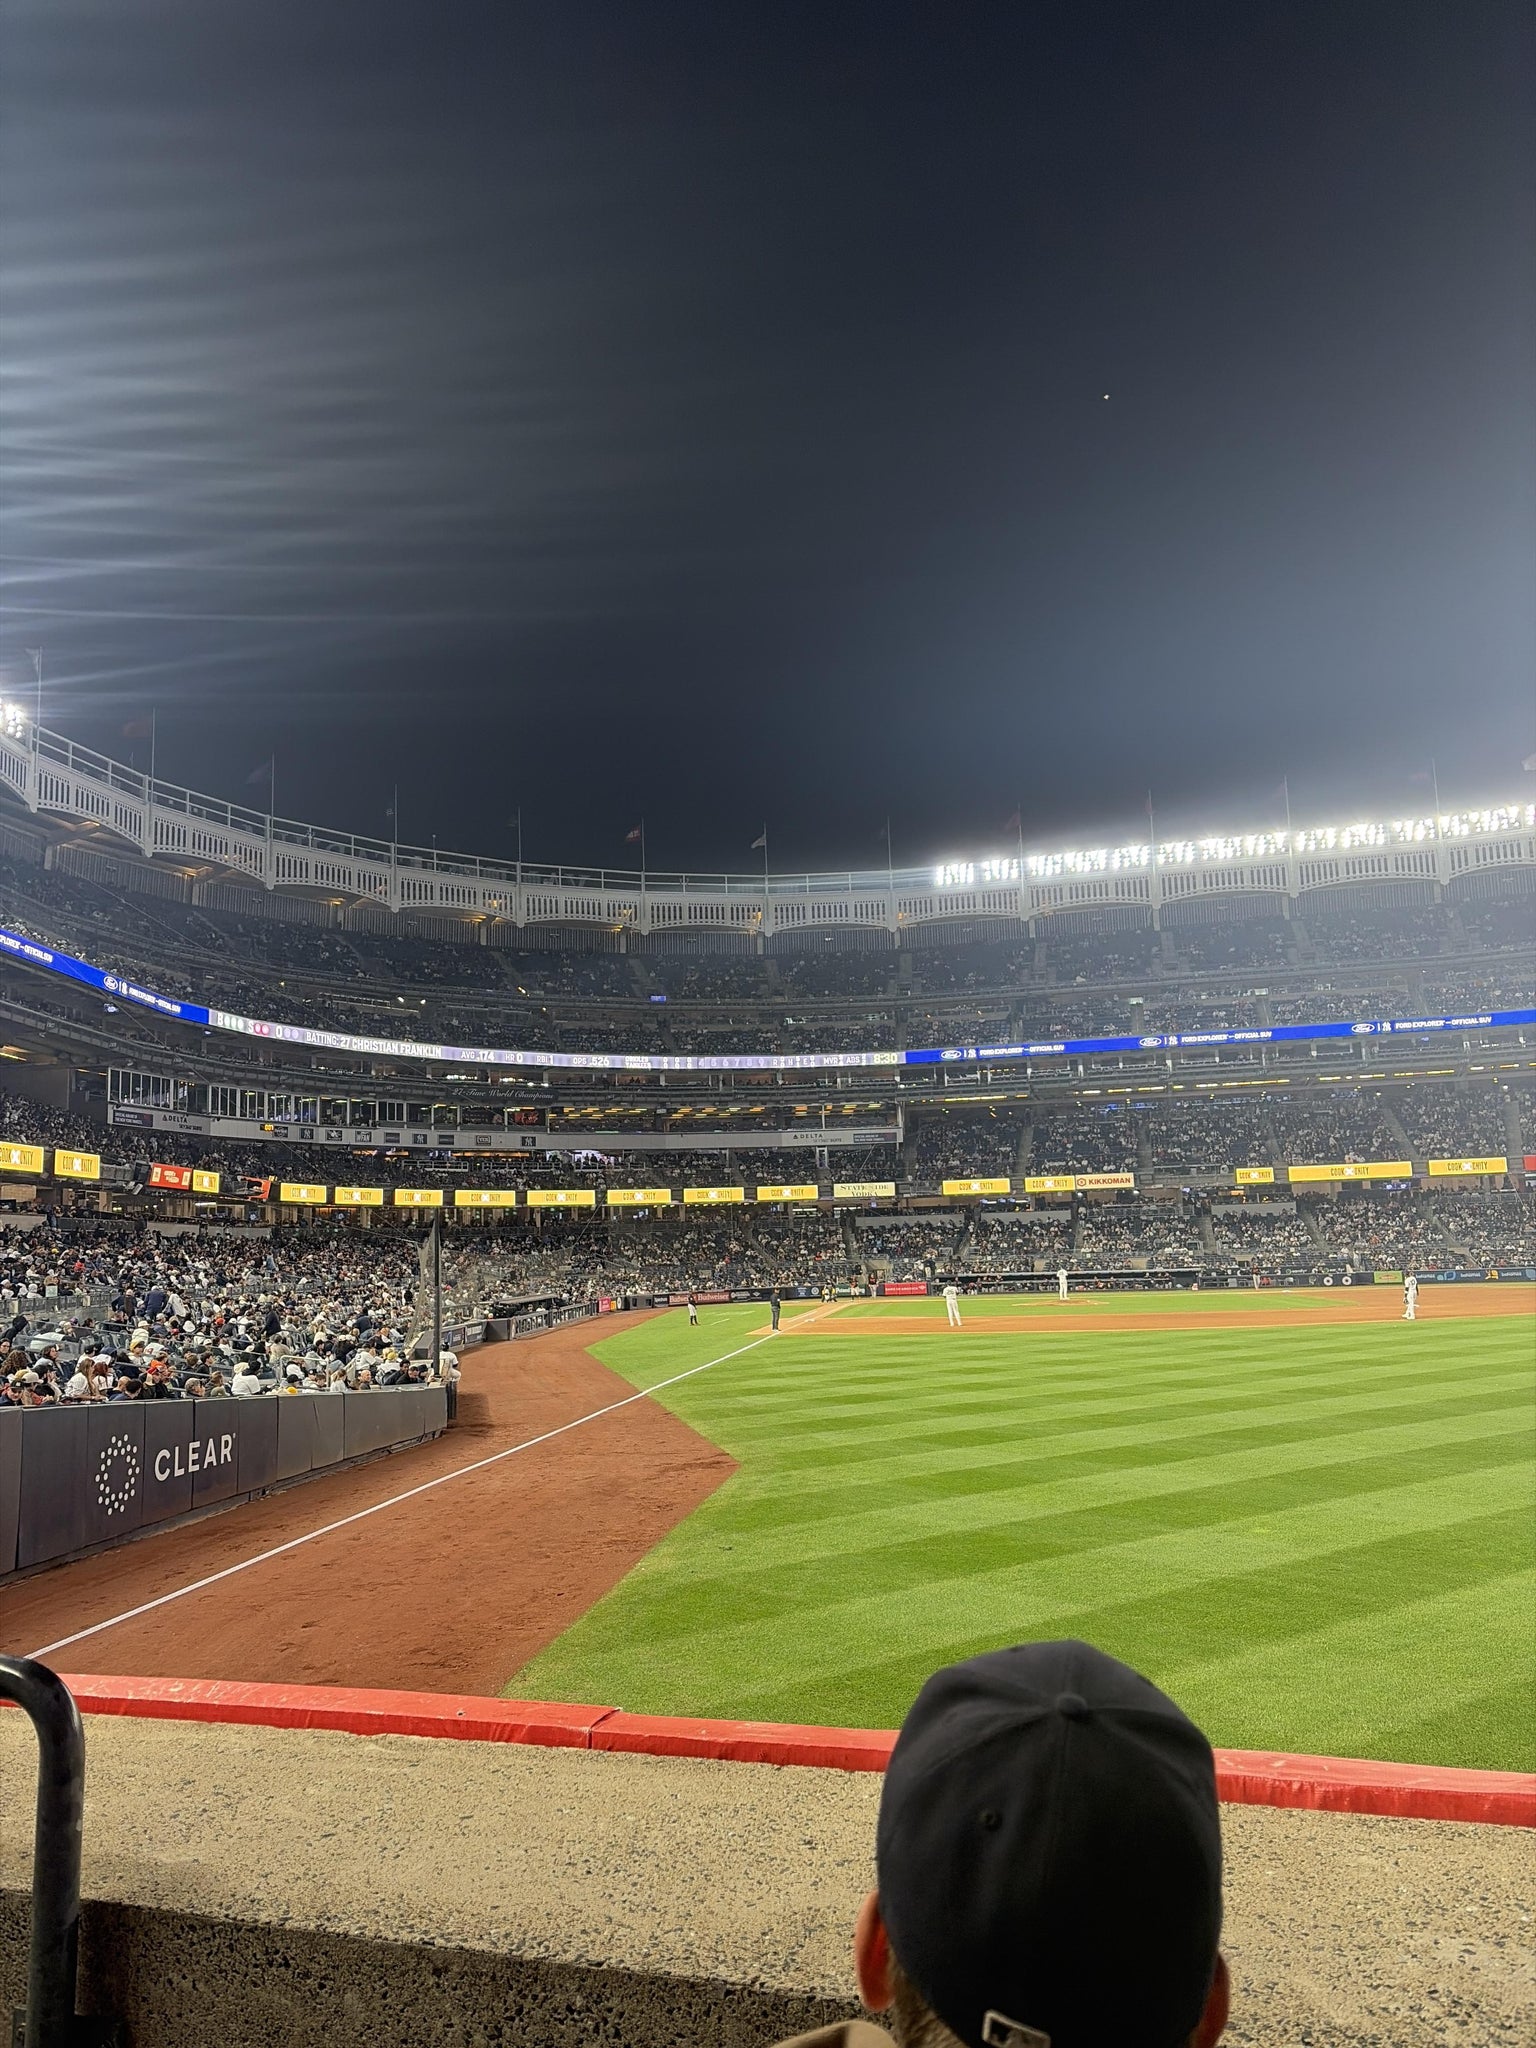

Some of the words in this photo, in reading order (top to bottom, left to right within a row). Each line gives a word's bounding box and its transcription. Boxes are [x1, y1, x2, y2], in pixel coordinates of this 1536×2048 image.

[1395, 1022, 1412, 1030] FORD
[1412, 1020, 1444, 1028] EXPLORER
[1451, 1018, 1478, 1026] OFFICIAL
[1479, 1016, 1492, 1024] SUV
[217, 1012, 223, 1026] B
[248, 1021, 254, 1033] S
[306, 1032, 340, 1046] BATTING:
[341, 1037, 350, 1048] 27
[352, 1039, 397, 1054] CHRISTIAN
[400, 1044, 442, 1057] FRANKLIN
[461, 1051, 475, 1059] AVG
[476, 1051, 495, 1061] .174
[505, 1053, 515, 1061] HR
[516, 1053, 523, 1062] 0
[536, 1055, 548, 1063] RBI
[589, 1056, 609, 1066] .526
[1234, 1032, 1260, 1040] OFFICIAL
[823, 1057, 839, 1065] MVR
[846, 1056, 860, 1064] ABS
[874, 1052, 897, 1064] 8:30
[488, 1089, 514, 1098] World
[515, 1089, 555, 1101] Champions
[168, 1115, 188, 1123] DELTA
[1088, 1177, 1131, 1186] KIKKOMAN
[698, 1293, 729, 1301] Budweiser
[155, 1434, 233, 1482] CLEAR
